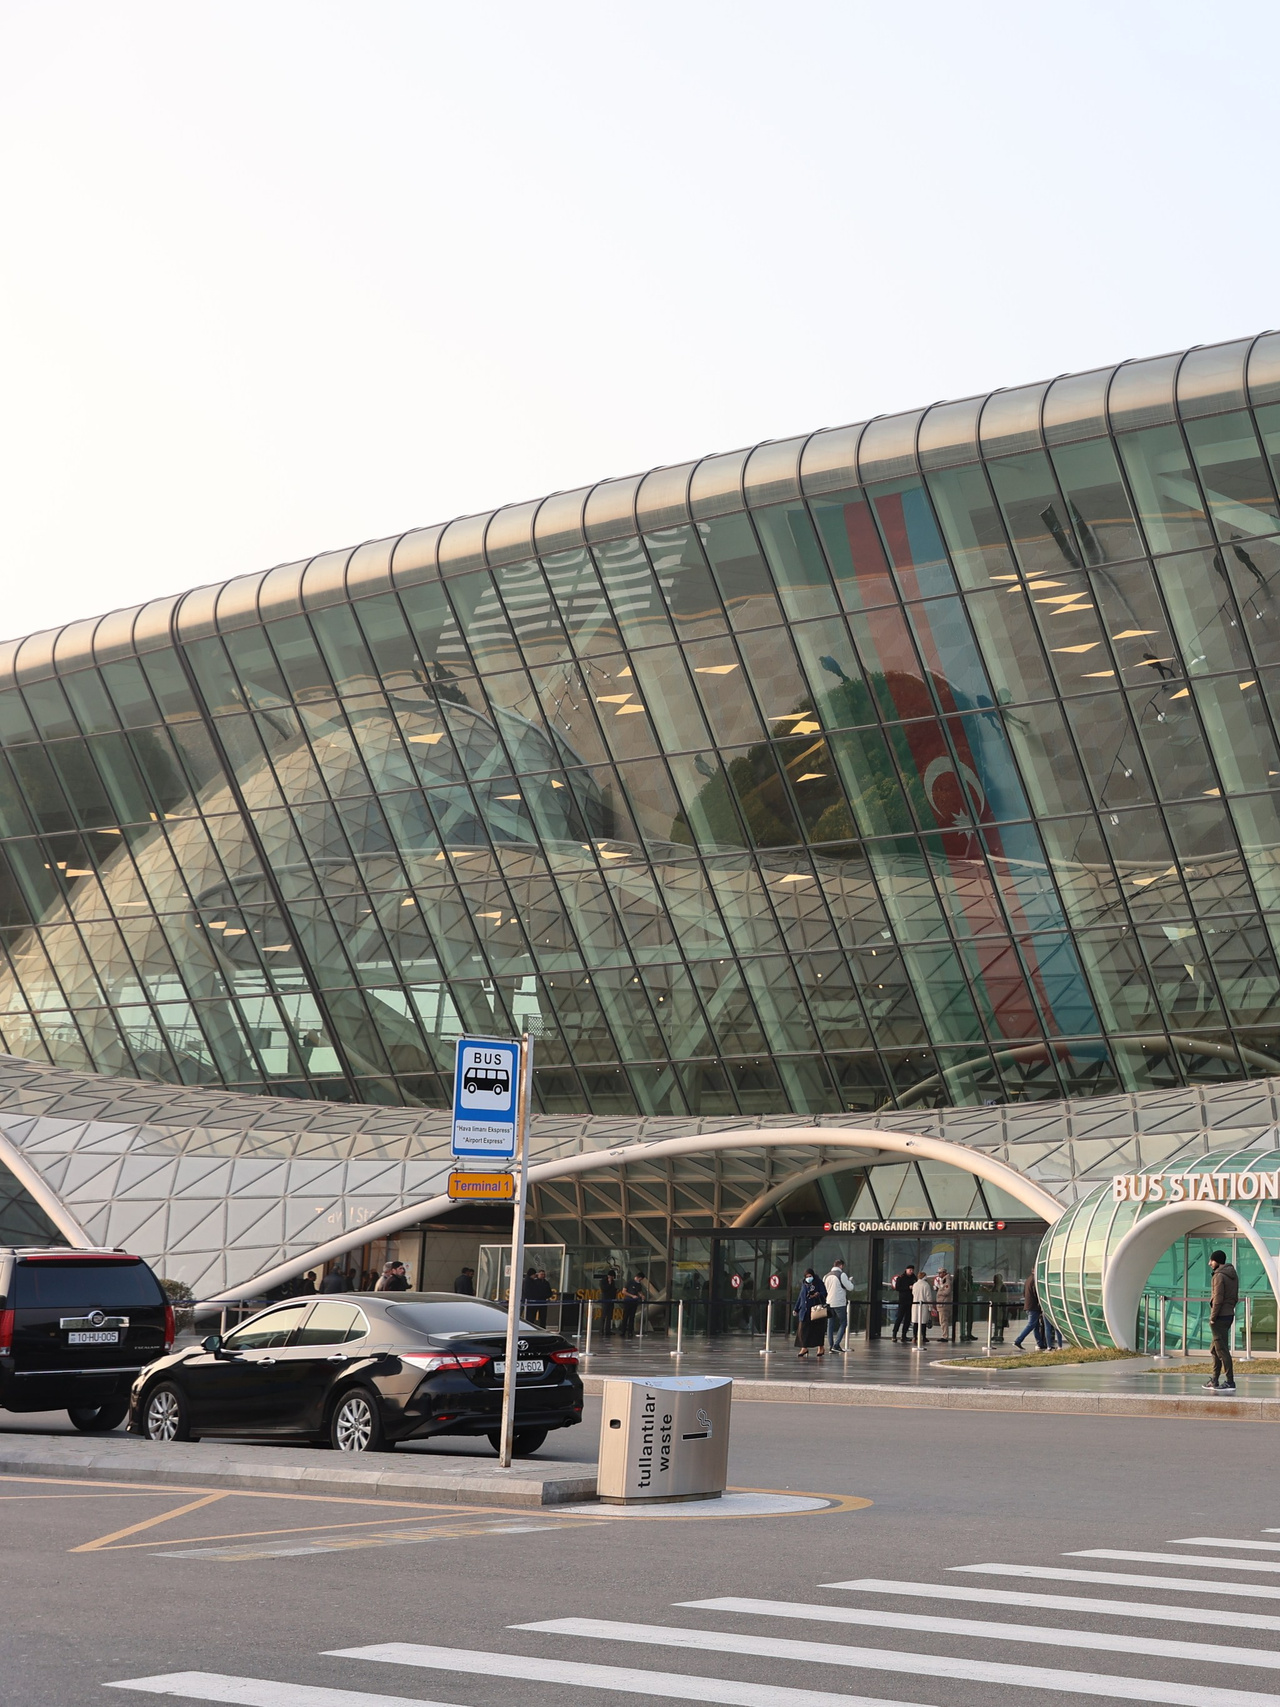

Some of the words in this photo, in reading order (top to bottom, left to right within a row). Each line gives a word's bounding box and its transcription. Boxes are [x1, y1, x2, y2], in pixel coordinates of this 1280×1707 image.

[474, 1052, 502, 1065] BUS
[454, 1179, 501, 1192] Terminal
[504, 1181, 509, 1191] 1
[1113, 1174, 1166, 1201] BUS
[833, 1220, 856, 1234] GİRİŞ
[859, 1220, 919, 1231] QADAĞANDIR
[921, 1221, 926, 1231] /
[929, 1221, 942, 1231] NO
[945, 1220, 994, 1231] ENTRANCE
[77, 1332, 117, 1342] 10-HU-005
[638, 1393, 656, 1488] tullantılar
[660, 1414, 673, 1472] waste
